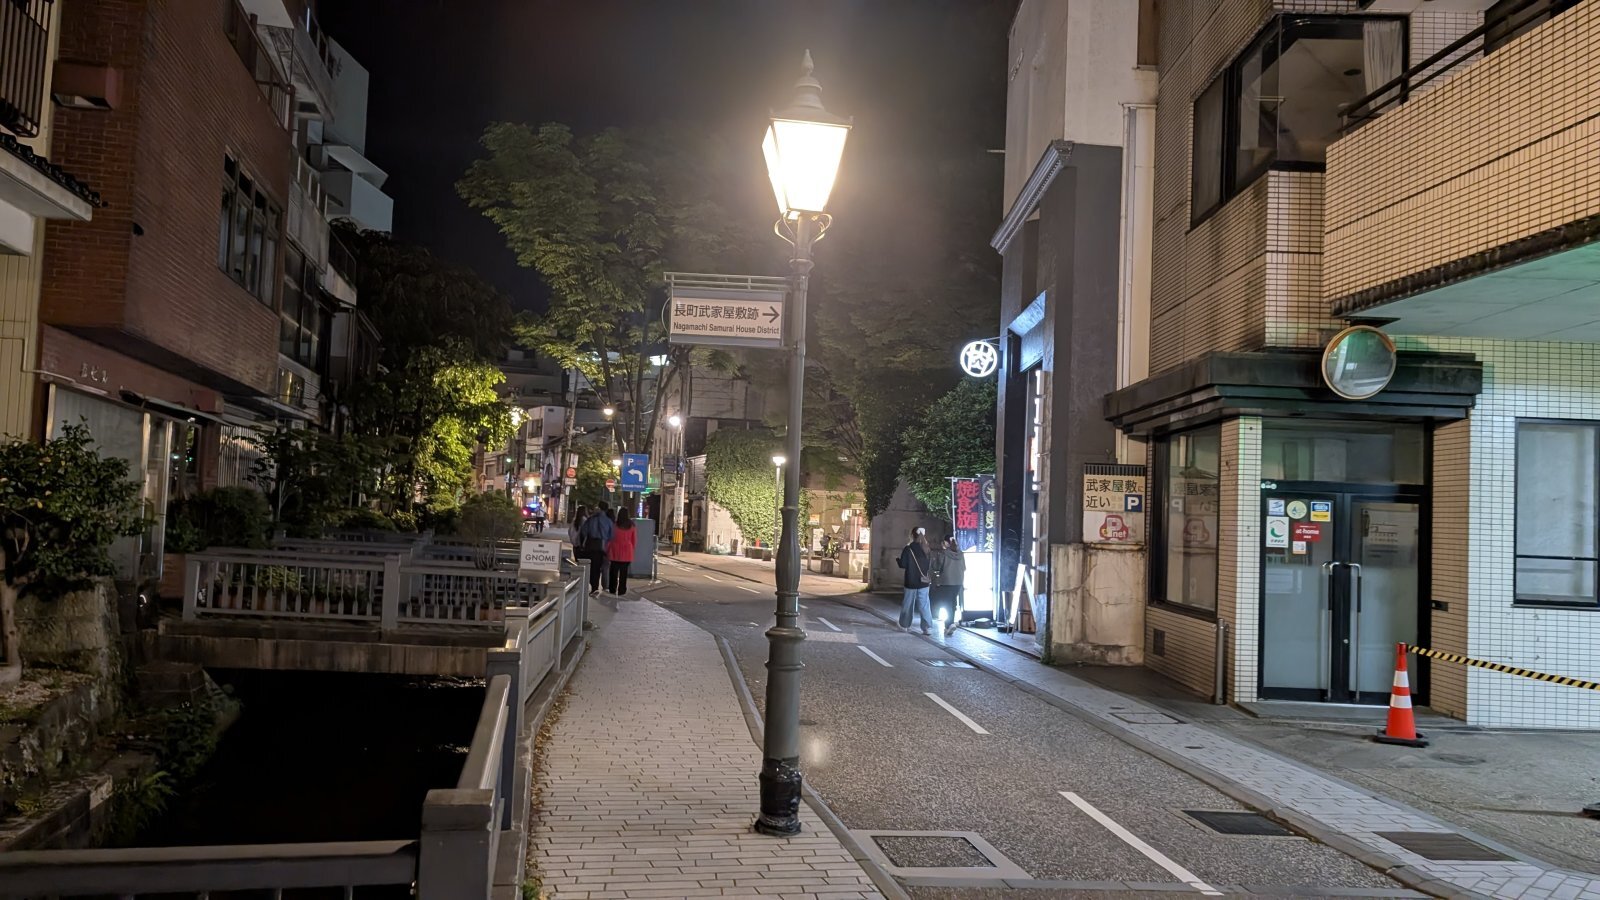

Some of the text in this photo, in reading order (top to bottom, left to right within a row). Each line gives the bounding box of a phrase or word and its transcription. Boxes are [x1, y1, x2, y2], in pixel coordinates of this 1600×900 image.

[674, 303, 760, 320] 長町武家屋敷跡
[673, 322, 780, 335] Nagamachi Samurai House District
[627, 458, 634, 467] P
[1086, 496, 1111, 508] 近い
[1127, 497, 1140, 510] P
[525, 554, 556, 562] GNOME
